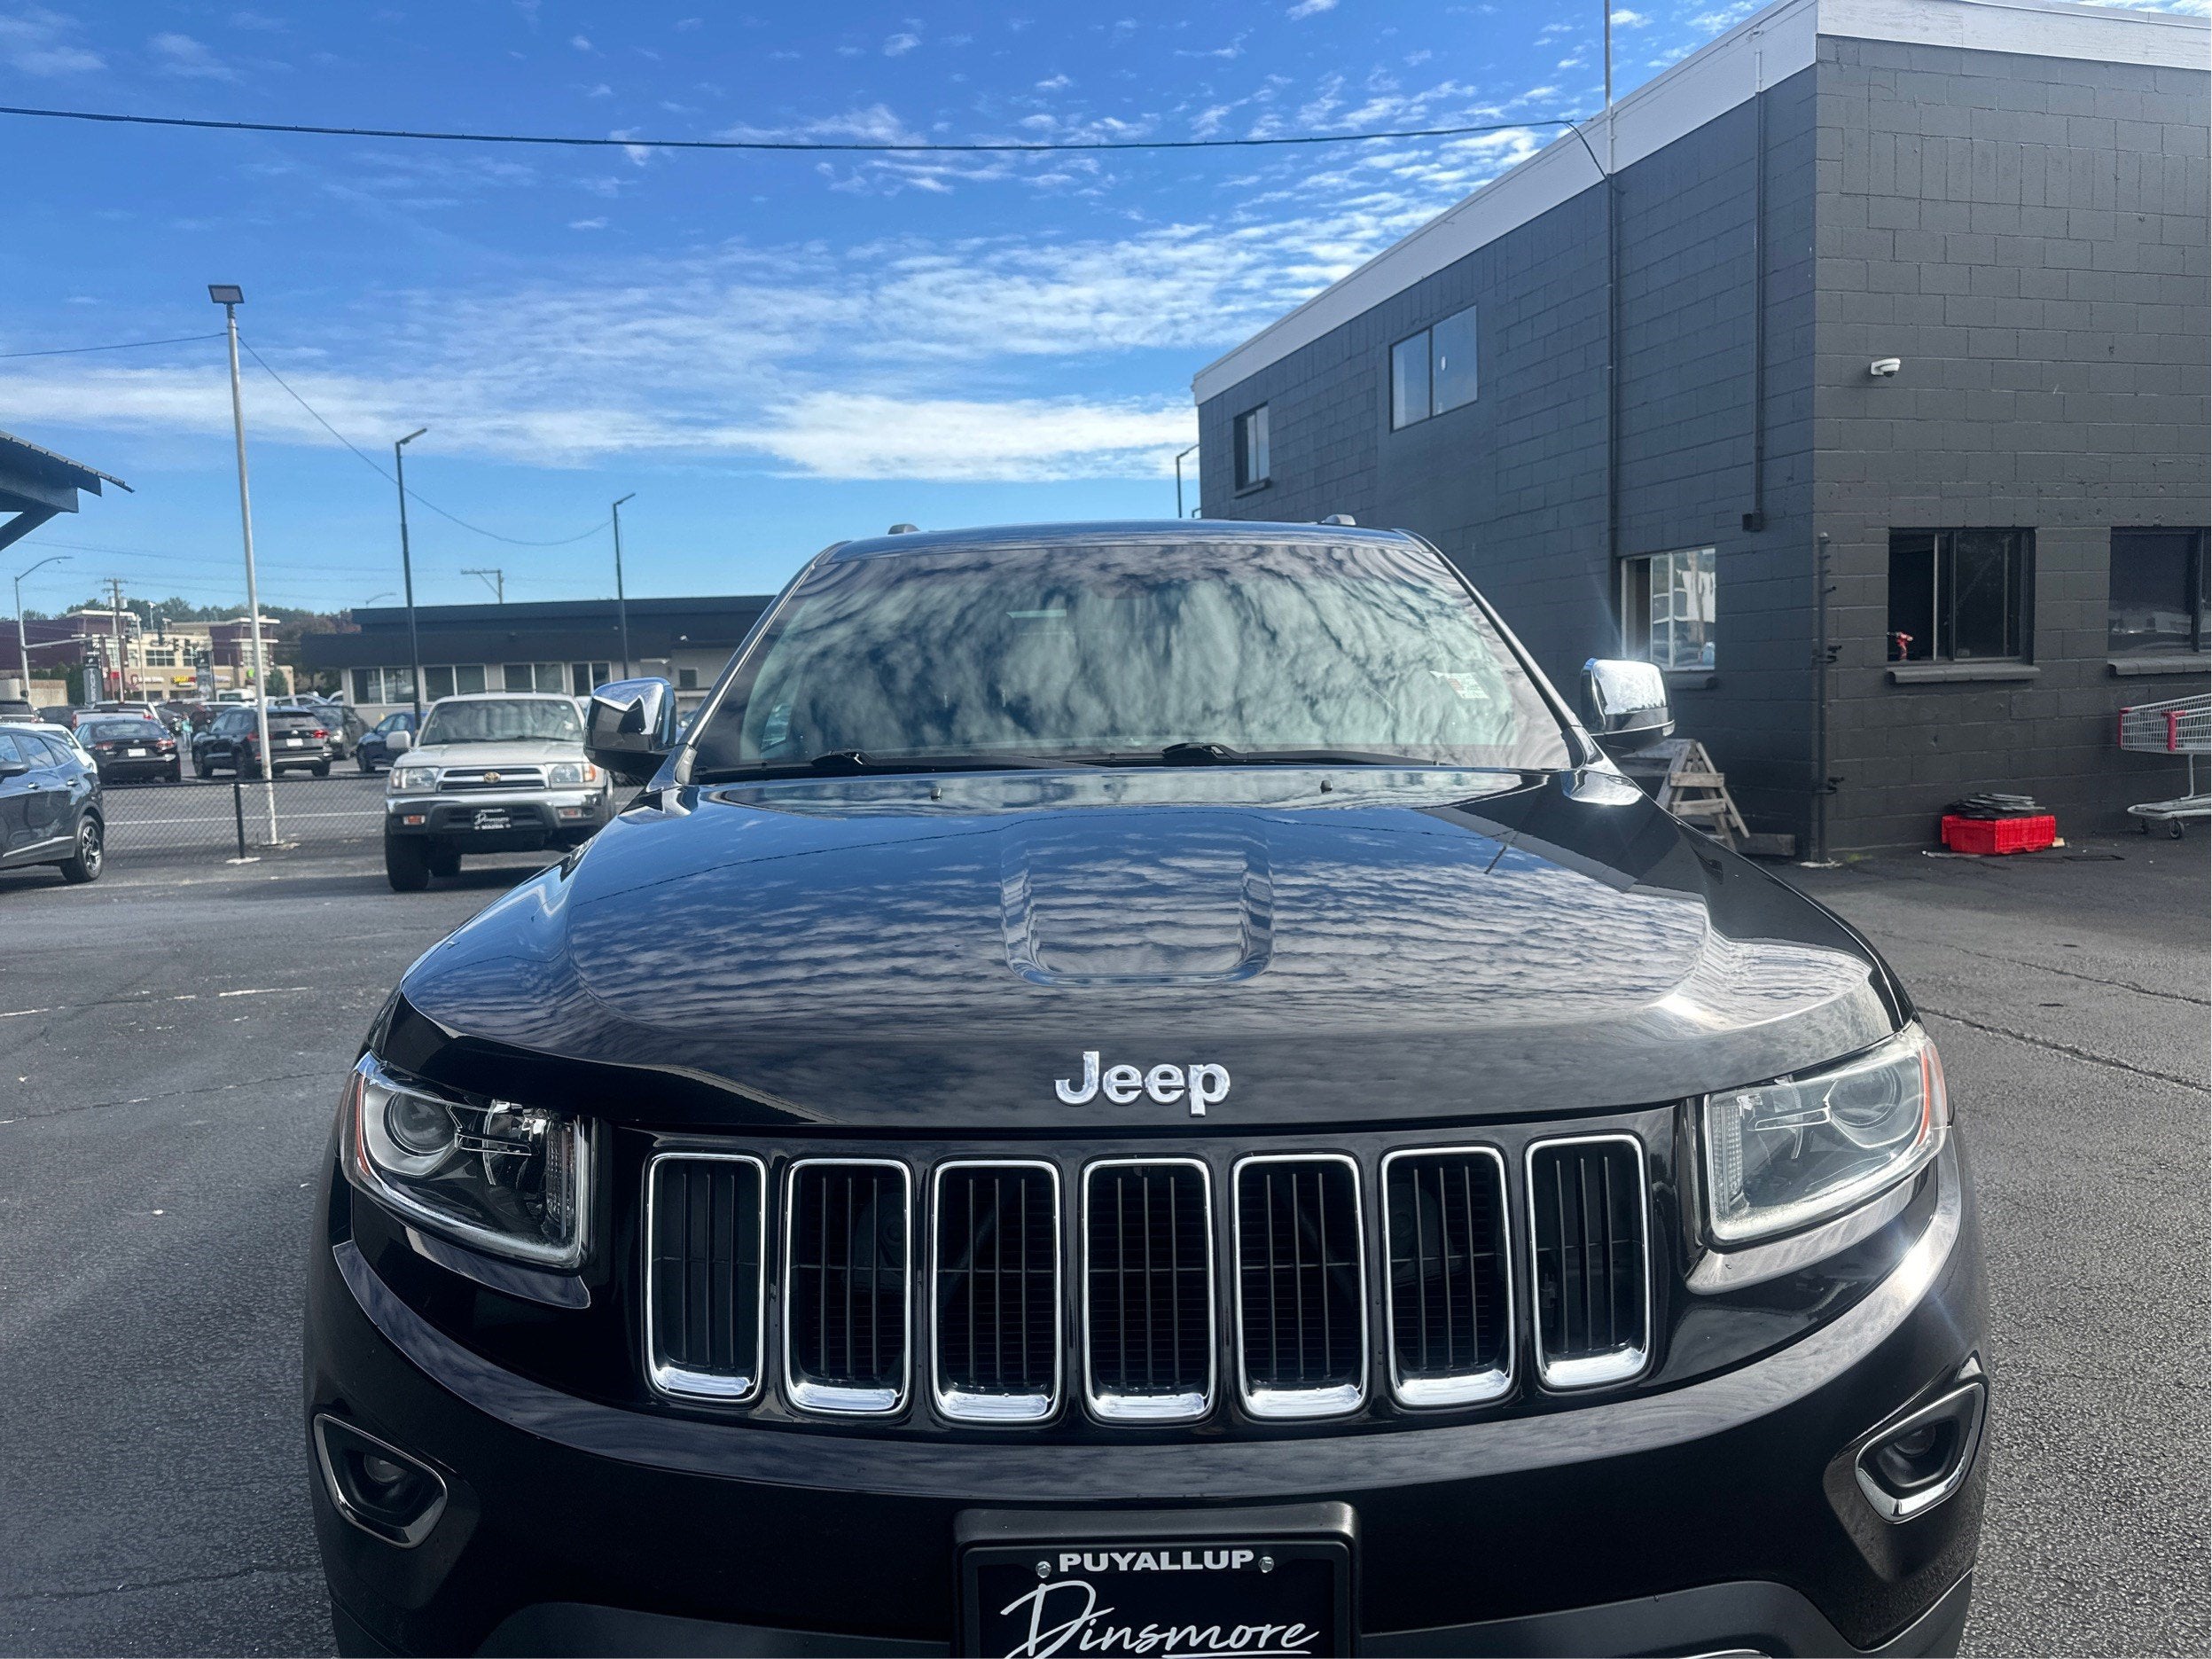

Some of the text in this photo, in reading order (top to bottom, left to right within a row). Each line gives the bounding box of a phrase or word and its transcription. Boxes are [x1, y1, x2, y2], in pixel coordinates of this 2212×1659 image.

[1054, 1051, 1231, 1117] Jeep
[1059, 1549, 1255, 1572] PUYALLUP
[999, 1579, 1320, 1659] Dinsmore
